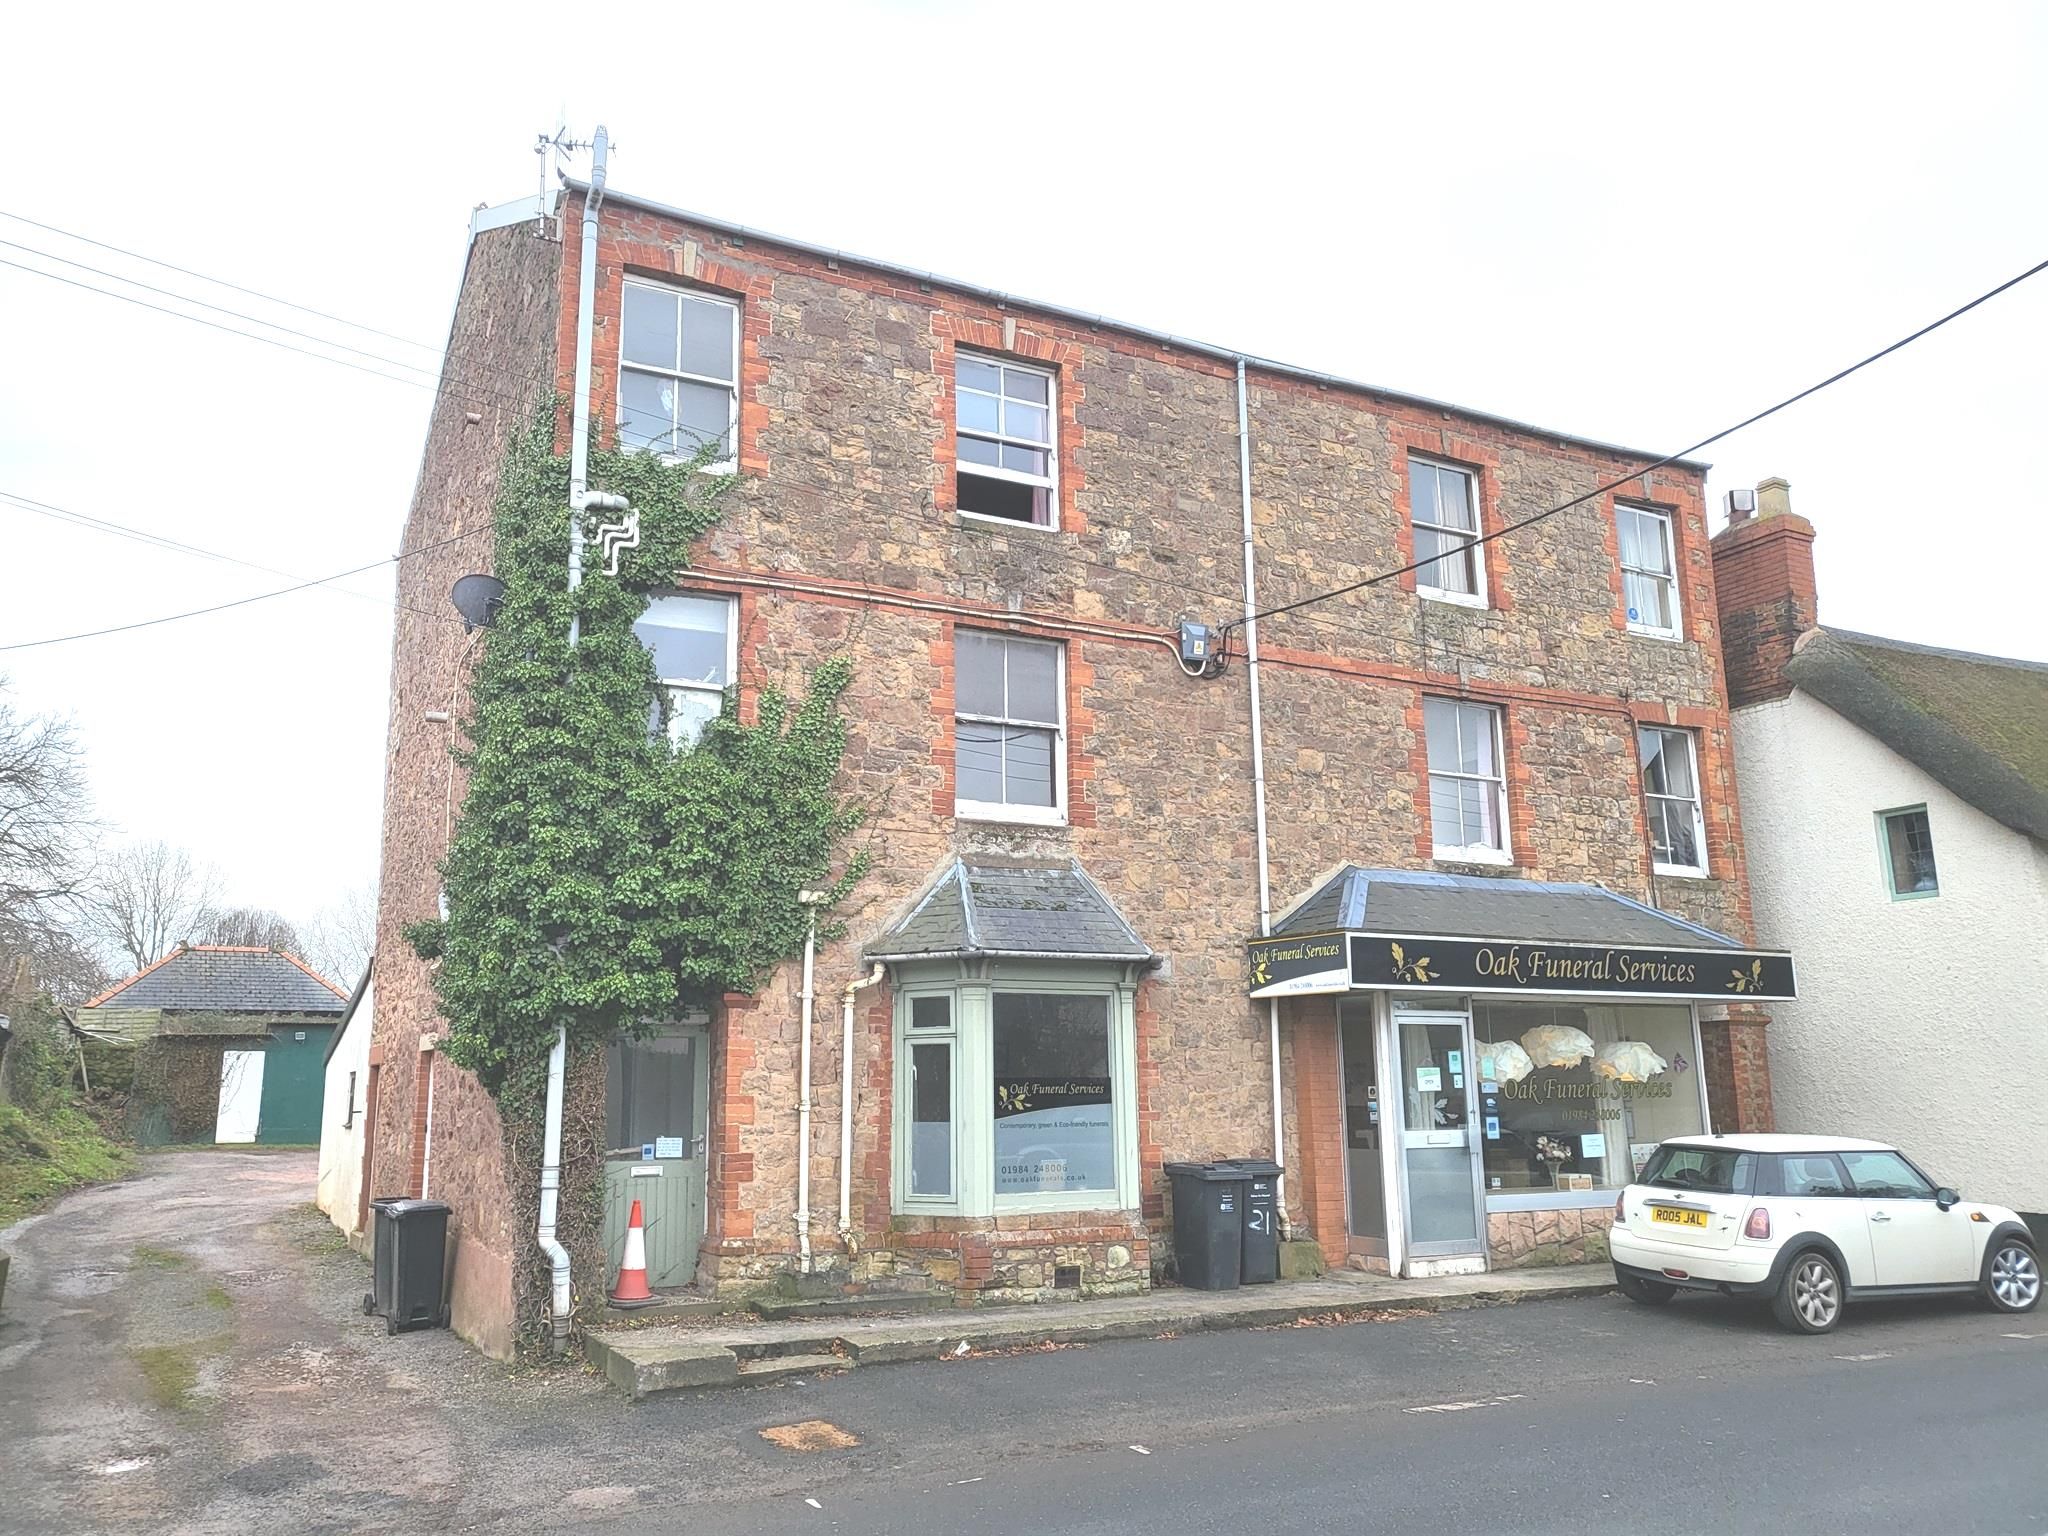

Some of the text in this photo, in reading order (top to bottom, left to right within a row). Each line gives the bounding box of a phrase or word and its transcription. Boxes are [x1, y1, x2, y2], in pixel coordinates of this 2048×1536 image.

[1252, 941, 1340, 965] Oak Funeral Services
[1475, 946, 1696, 984] Oak Funeral Services
[1010, 1082, 1105, 1096] Oak Funeral Services
[1504, 1075, 1673, 1104] Oak Funeral Services
[1001, 1164, 1068, 1174] 01984 248006
[1683, 1212, 1703, 1225] JAL
